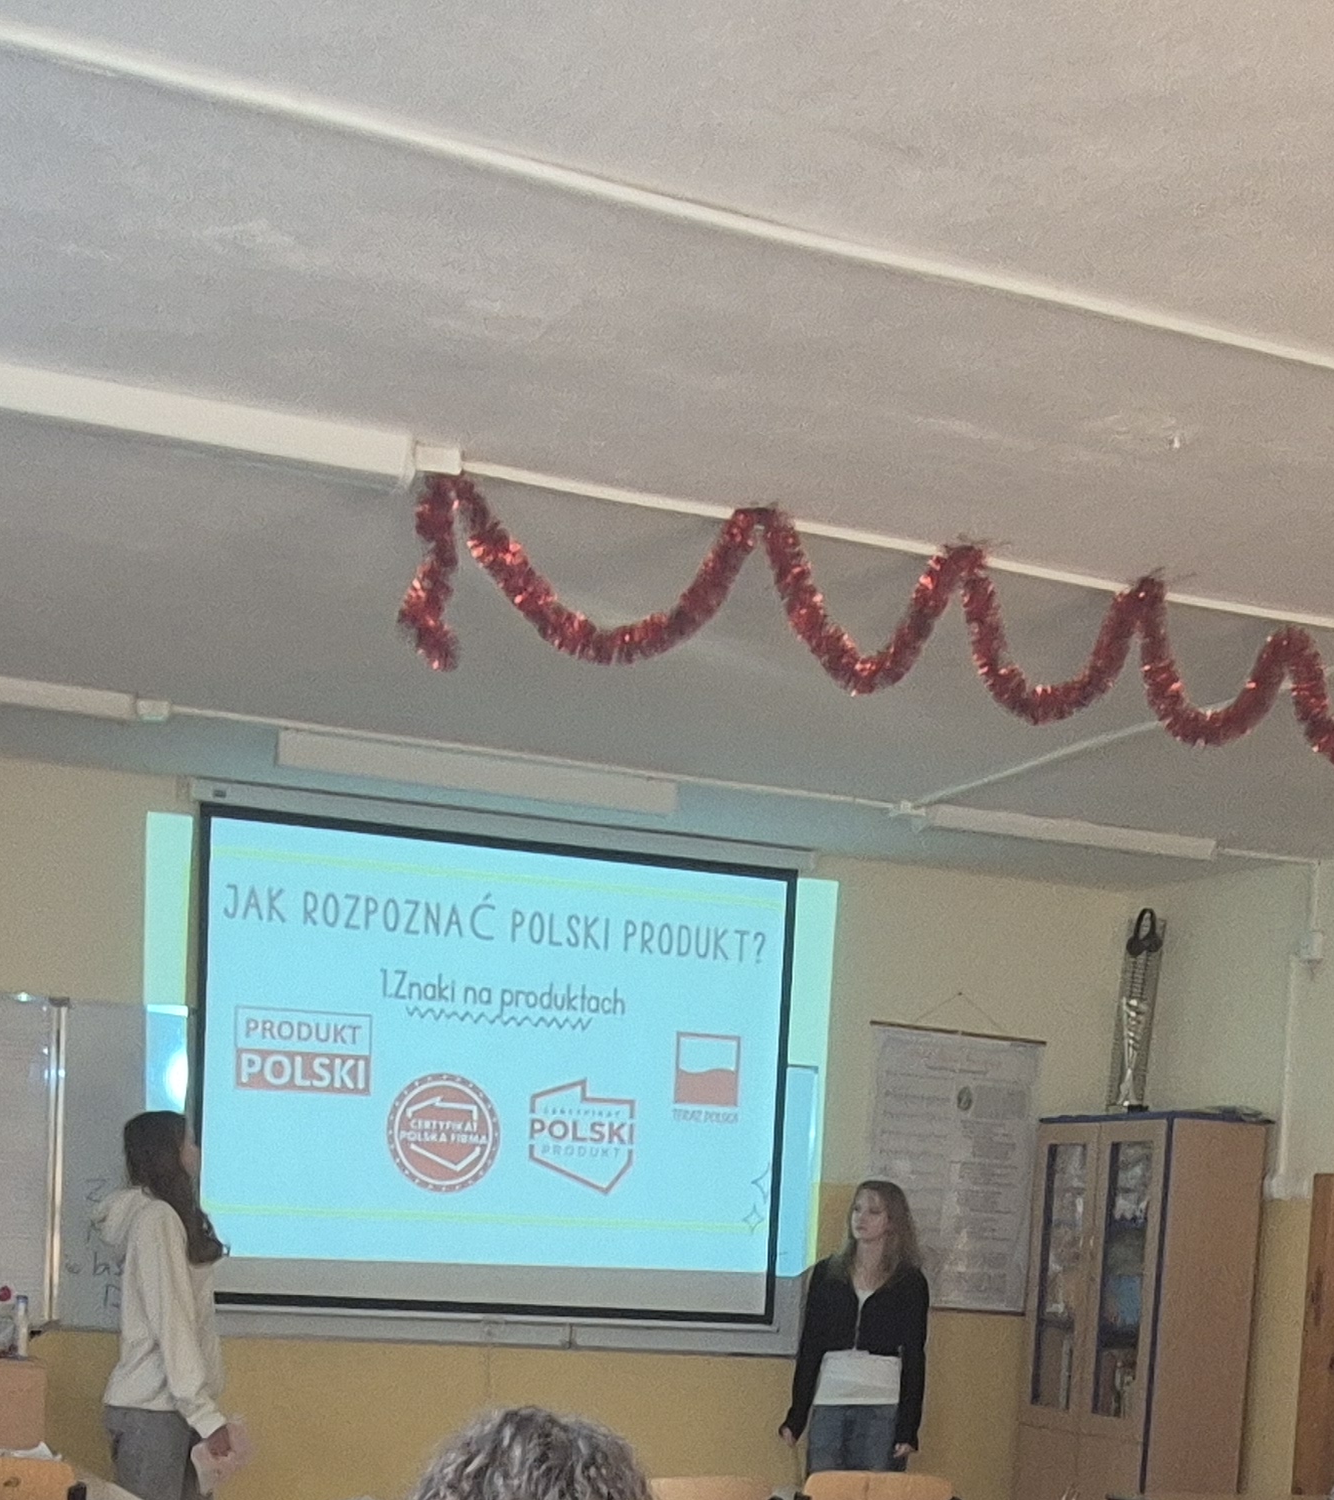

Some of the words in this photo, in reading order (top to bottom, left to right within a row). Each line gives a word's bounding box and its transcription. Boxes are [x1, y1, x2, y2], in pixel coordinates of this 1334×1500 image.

[222, 883, 286, 923] JAK
[302, 891, 496, 941] ROZPOZNAĆ
[511, 909, 610, 951] POLSKI
[623, 919, 767, 964] PRODUKT?
[464, 986, 492, 1005] na
[500, 982, 626, 1017] produktach
[245, 1018, 362, 1045] PRODUKT
[240, 1052, 366, 1090] POLSKI
[530, 1118, 634, 1145] POLSKI
[541, 1144, 620, 1158] PRODUKT
